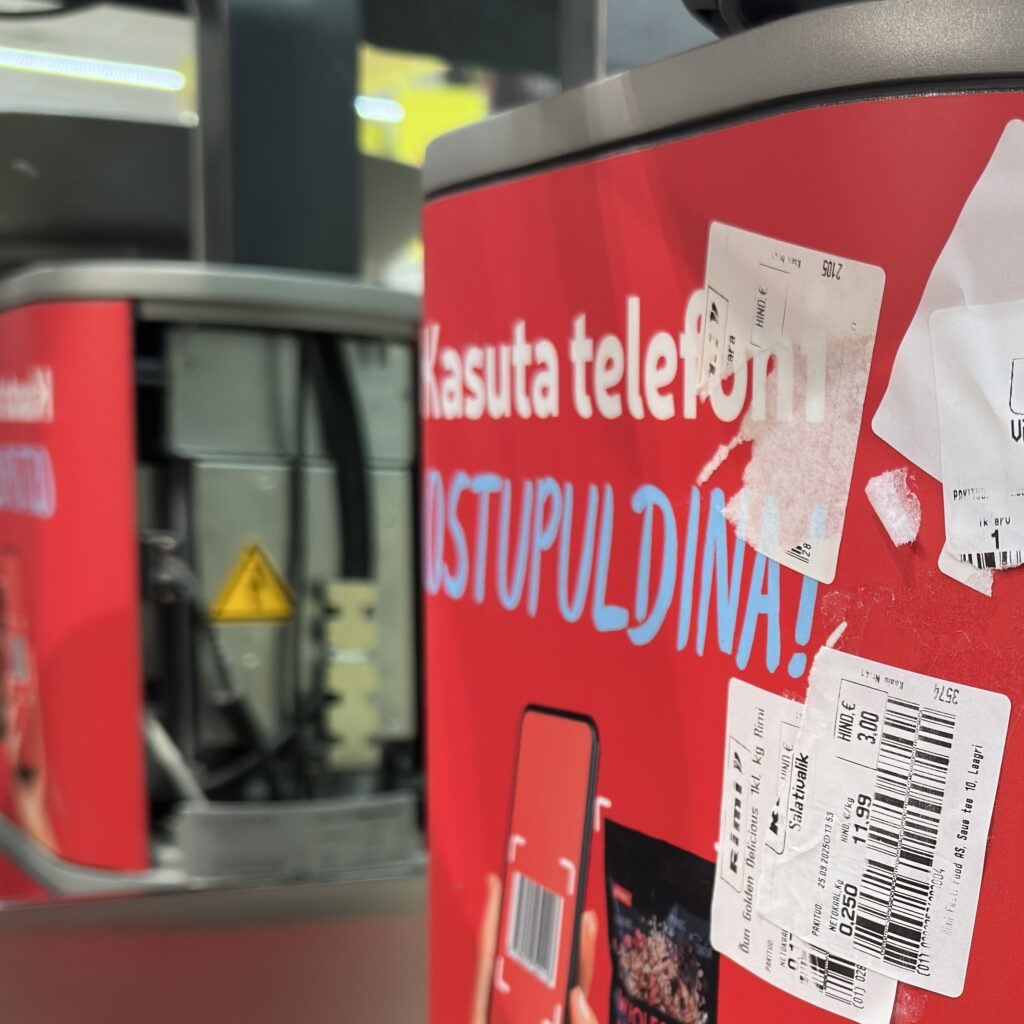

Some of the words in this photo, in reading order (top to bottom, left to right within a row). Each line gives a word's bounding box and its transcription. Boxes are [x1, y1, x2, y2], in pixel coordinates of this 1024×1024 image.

[822, 260, 843, 280] 2105
[421, 321, 559, 420] Kasuta
[990, 529, 1000, 550] 1
[934, 684, 959, 704] 3574
[753, 707, 765, 739] Rimi
[838, 701, 855, 742] HIND,€
[857, 711, 879, 744] 3,00
[752, 747, 764, 765] kg
[968, 745, 983, 774] Laagri
[789, 753, 808, 829] Salativalik
[965, 781, 977, 790] 10,
[853, 794, 876, 844] 11,99
[961, 798, 973, 813] tee
[730, 783, 754, 873] Rimi
[746, 807, 758, 868] Delicious
[957, 820, 969, 840] Saue
[954, 847, 966, 858] AS,
[742, 875, 754, 922] Golden
[839, 884, 861, 936] 0,250
[850, 987, 866, 1009] (01)
